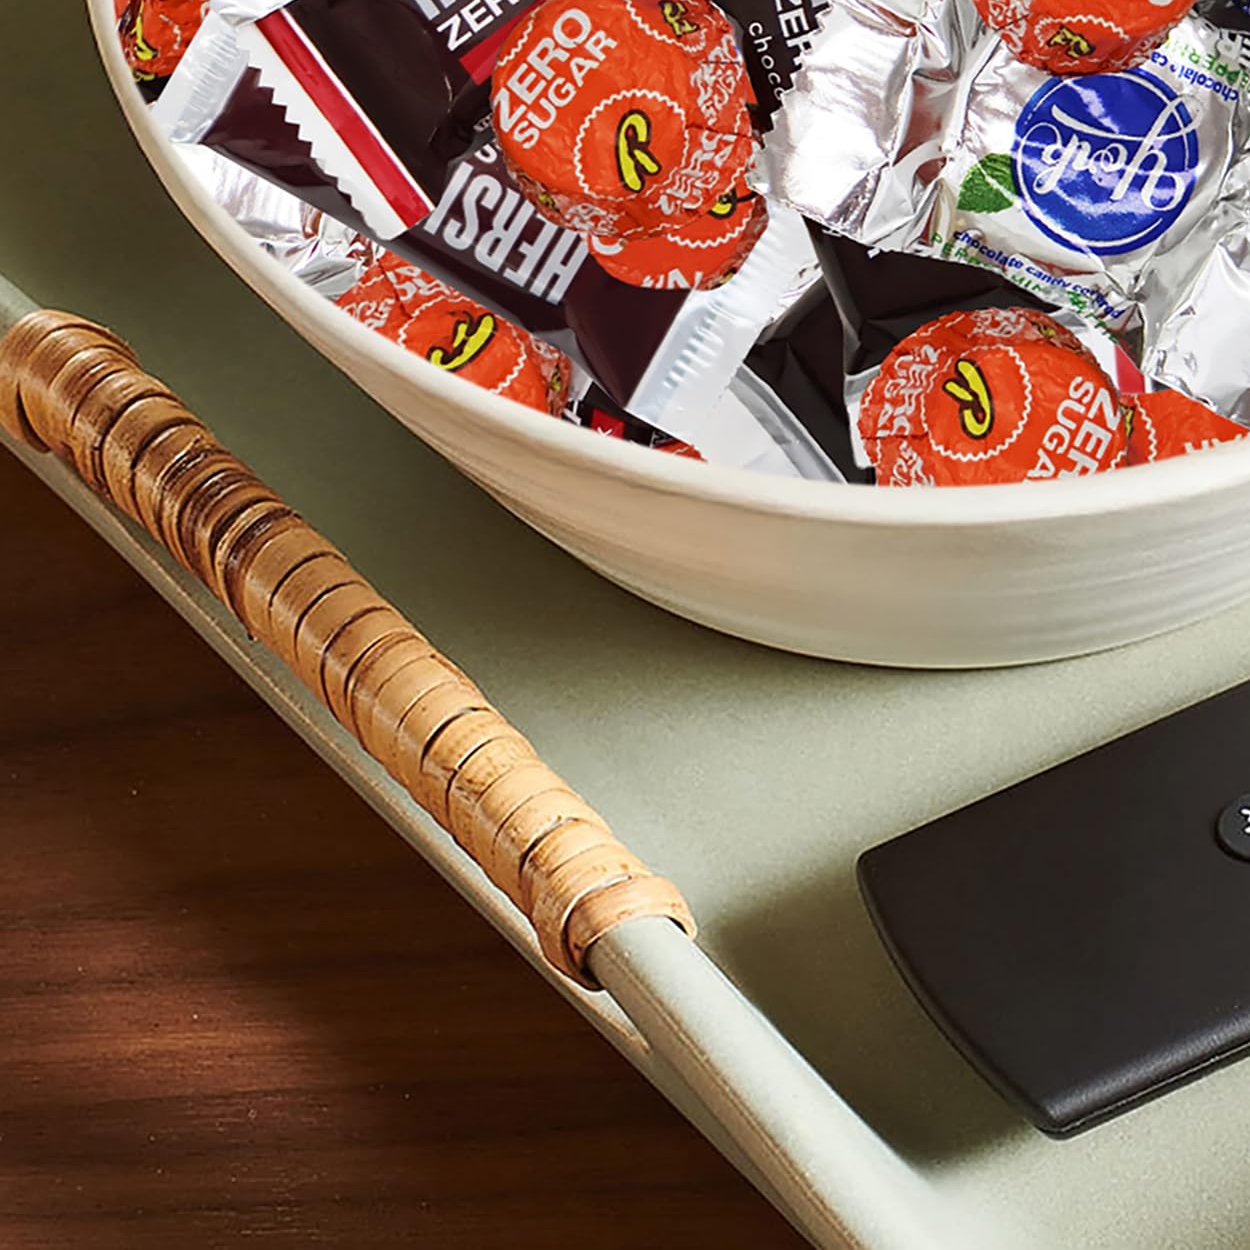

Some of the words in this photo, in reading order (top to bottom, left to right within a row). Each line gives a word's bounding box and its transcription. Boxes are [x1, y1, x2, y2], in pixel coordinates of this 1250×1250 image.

[492, 7, 593, 133] ZERO
[511, 29, 618, 150] SUGAR
[1033, 95, 1201, 211] York
